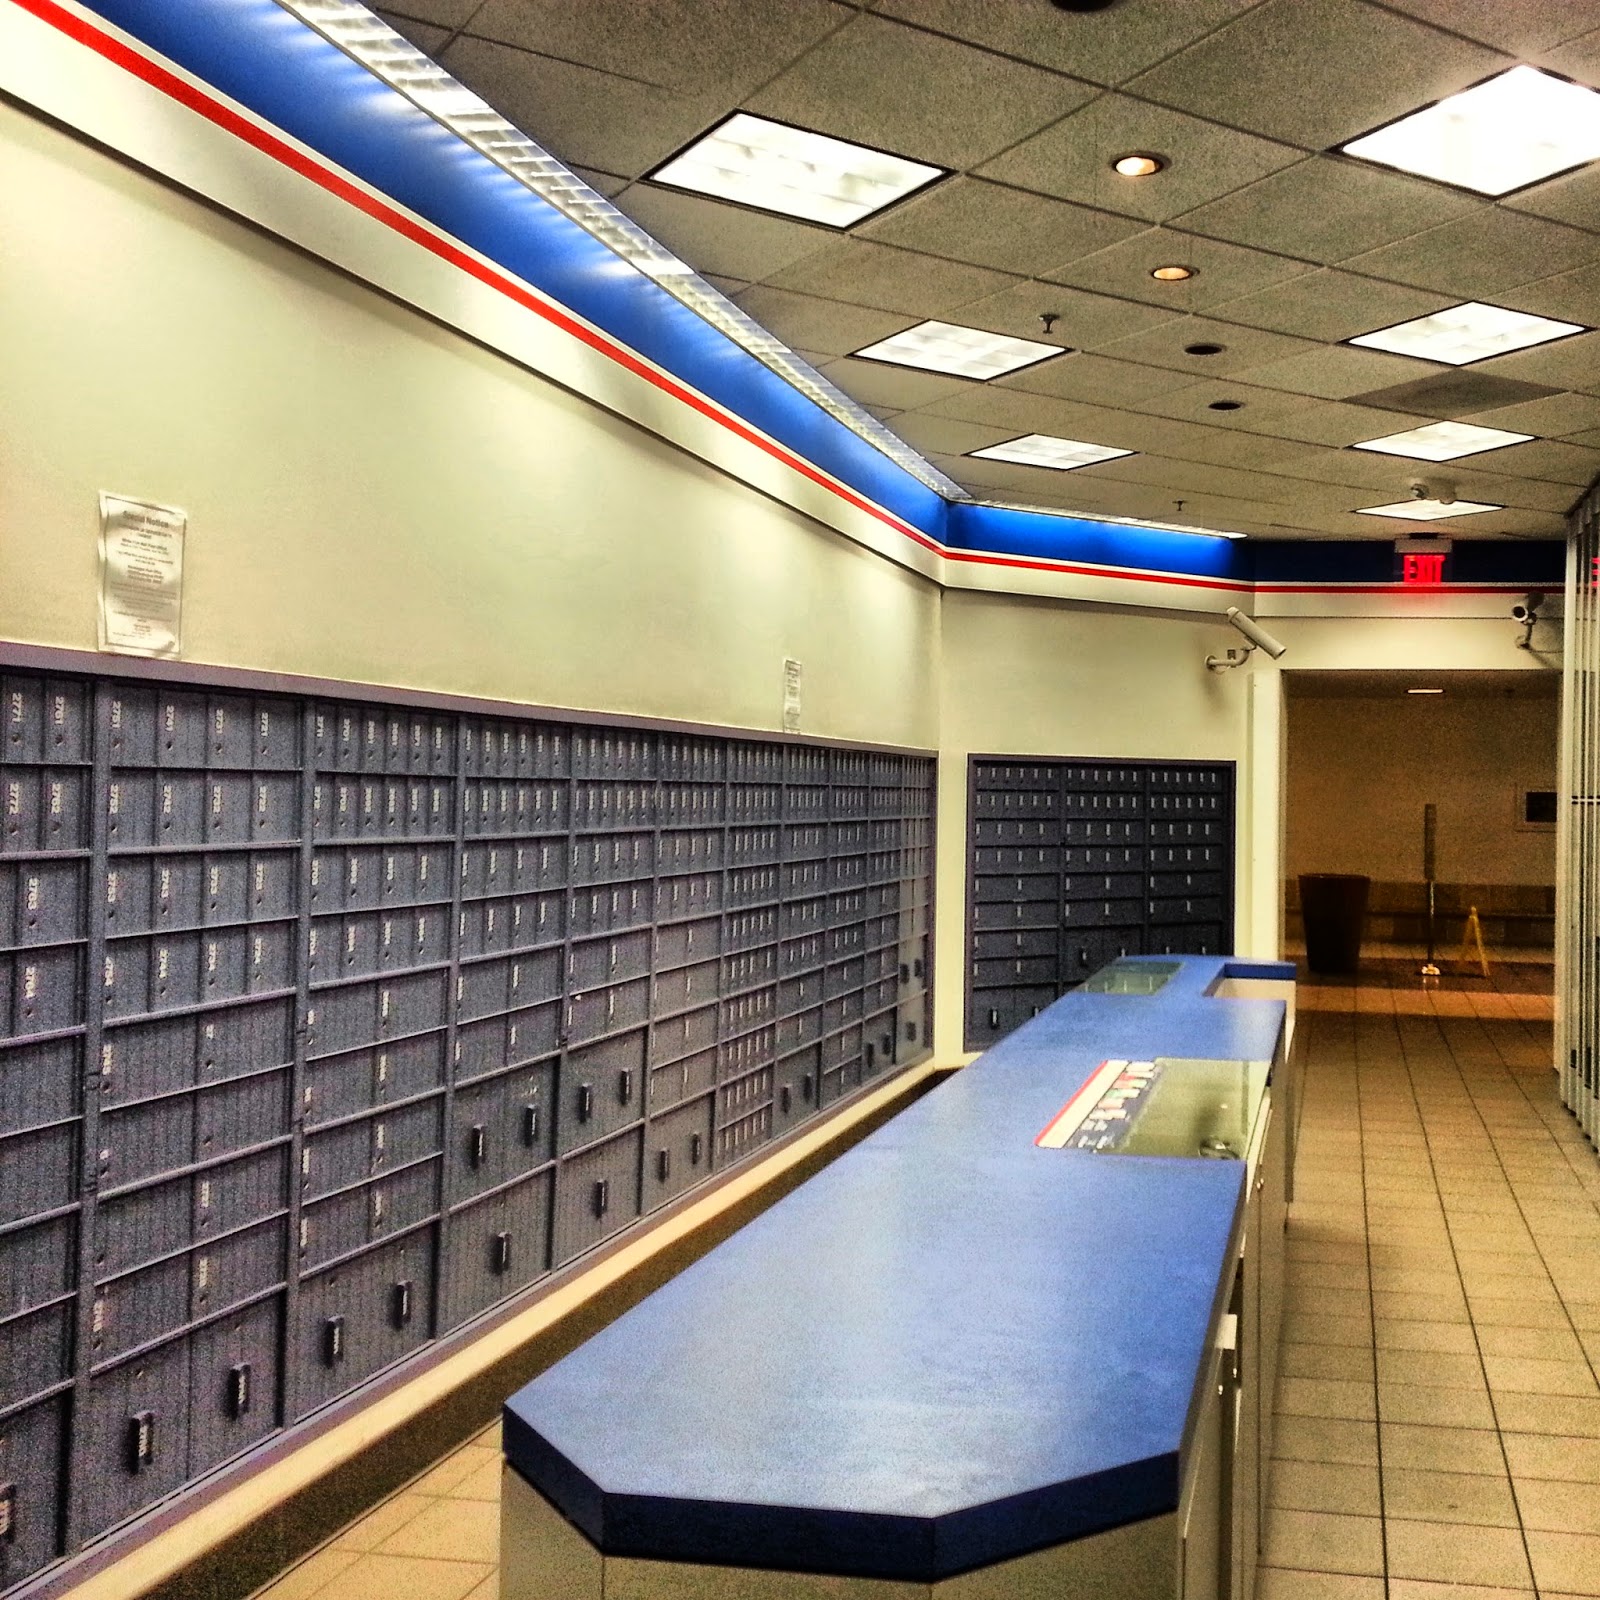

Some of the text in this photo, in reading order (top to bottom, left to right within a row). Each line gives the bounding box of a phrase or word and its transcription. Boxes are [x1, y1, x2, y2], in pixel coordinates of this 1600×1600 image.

[123, 510, 169, 528] Special Notice
[1403, 555, 1445, 584] EXIT
[11, 693, 24, 724] 2771
[54, 696, 65, 725] 2761
[112, 701, 121, 729] 2751
[165, 705, 175, 732] 2741
[215, 709, 224, 735] 2731
[260, 712, 269, 737] 2721
[9, 783, 20, 815] 2772
[51, 783, 62, 814] 2762
[109, 784, 119, 814] 2752
[163, 785, 172, 814] 2742
[213, 785, 221, 813] 2732
[258, 786, 267, 812] 2722
[28, 878, 39, 910] 2763
[107, 872, 117, 903] 2753
[161, 869, 170, 899] 2743
[159, 949, 168, 979] 2744
[25, 966, 37, 999] 2764
